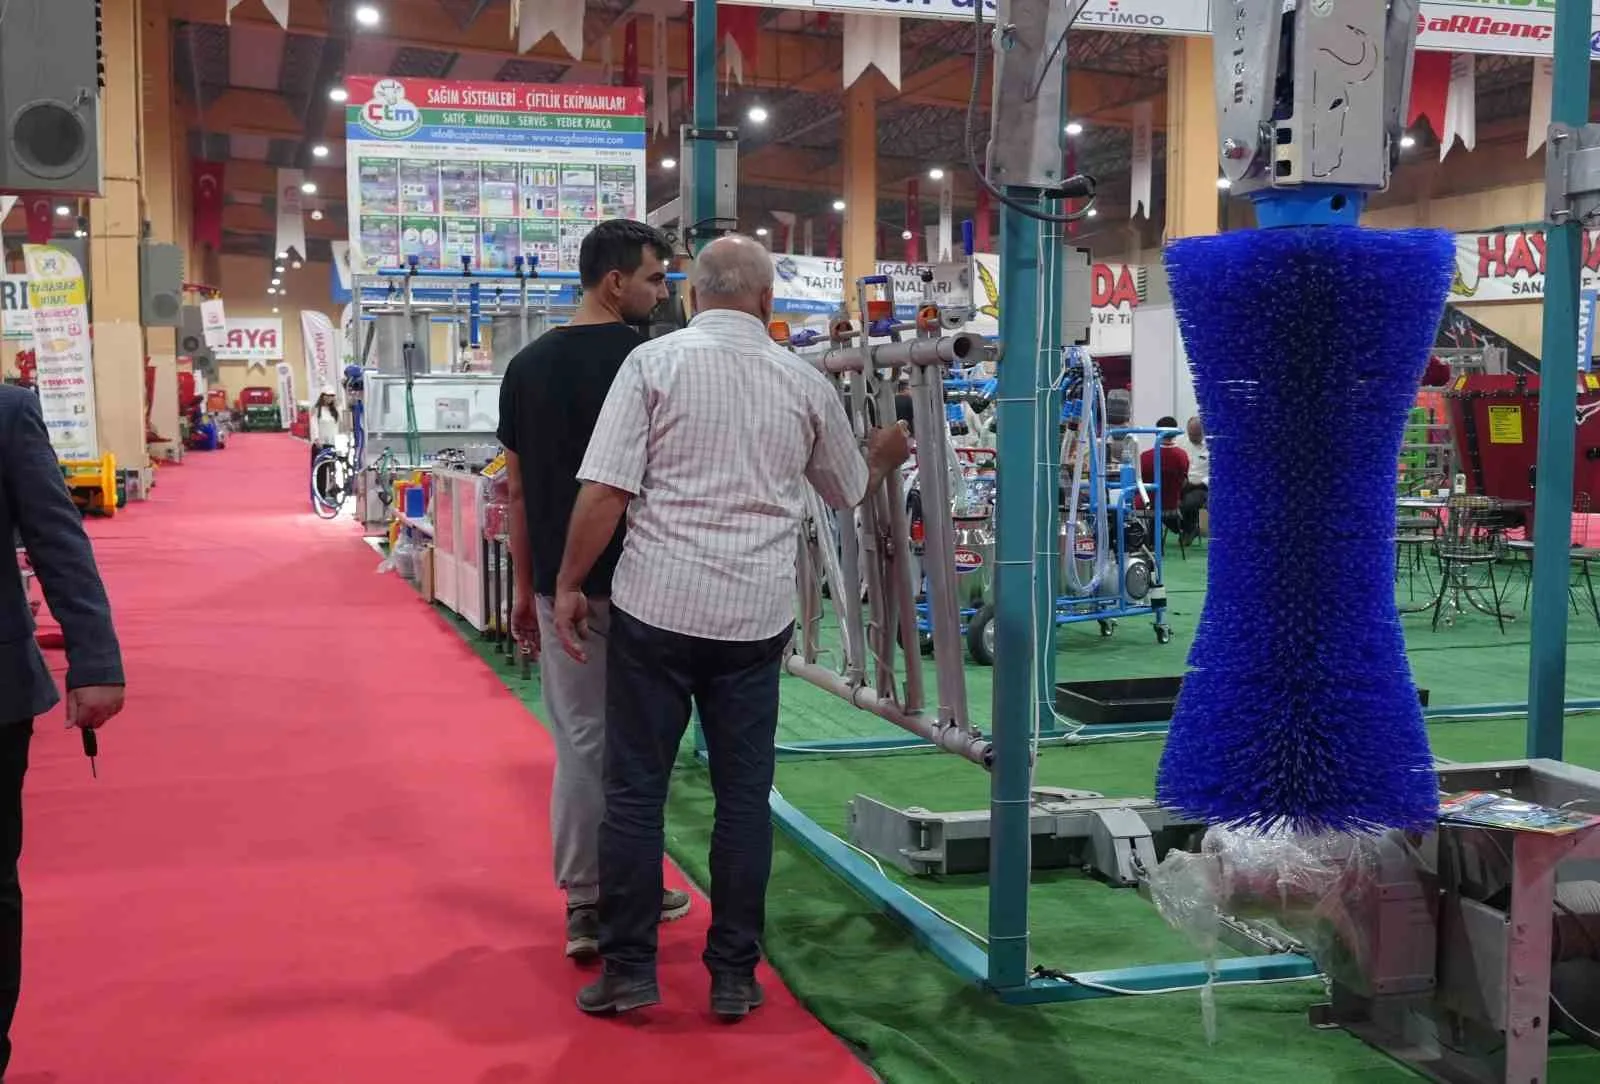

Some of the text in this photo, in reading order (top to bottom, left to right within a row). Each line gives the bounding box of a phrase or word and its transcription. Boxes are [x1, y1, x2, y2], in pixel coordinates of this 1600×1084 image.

[427, 86, 459, 105] SAĞIM
[462, 86, 516, 107] SİSTEMLERİ
[526, 89, 561, 111] ÇİFTLİK
[563, 90, 627, 112] EKİPMANLARI
[442, 112, 466, 126] SATIŞ
[475, 113, 510, 126] MONTAJ
[519, 113, 549, 128] SERVİS
[556, 116, 583, 129] YEDEK
[585, 118, 612, 131] PARÇA
